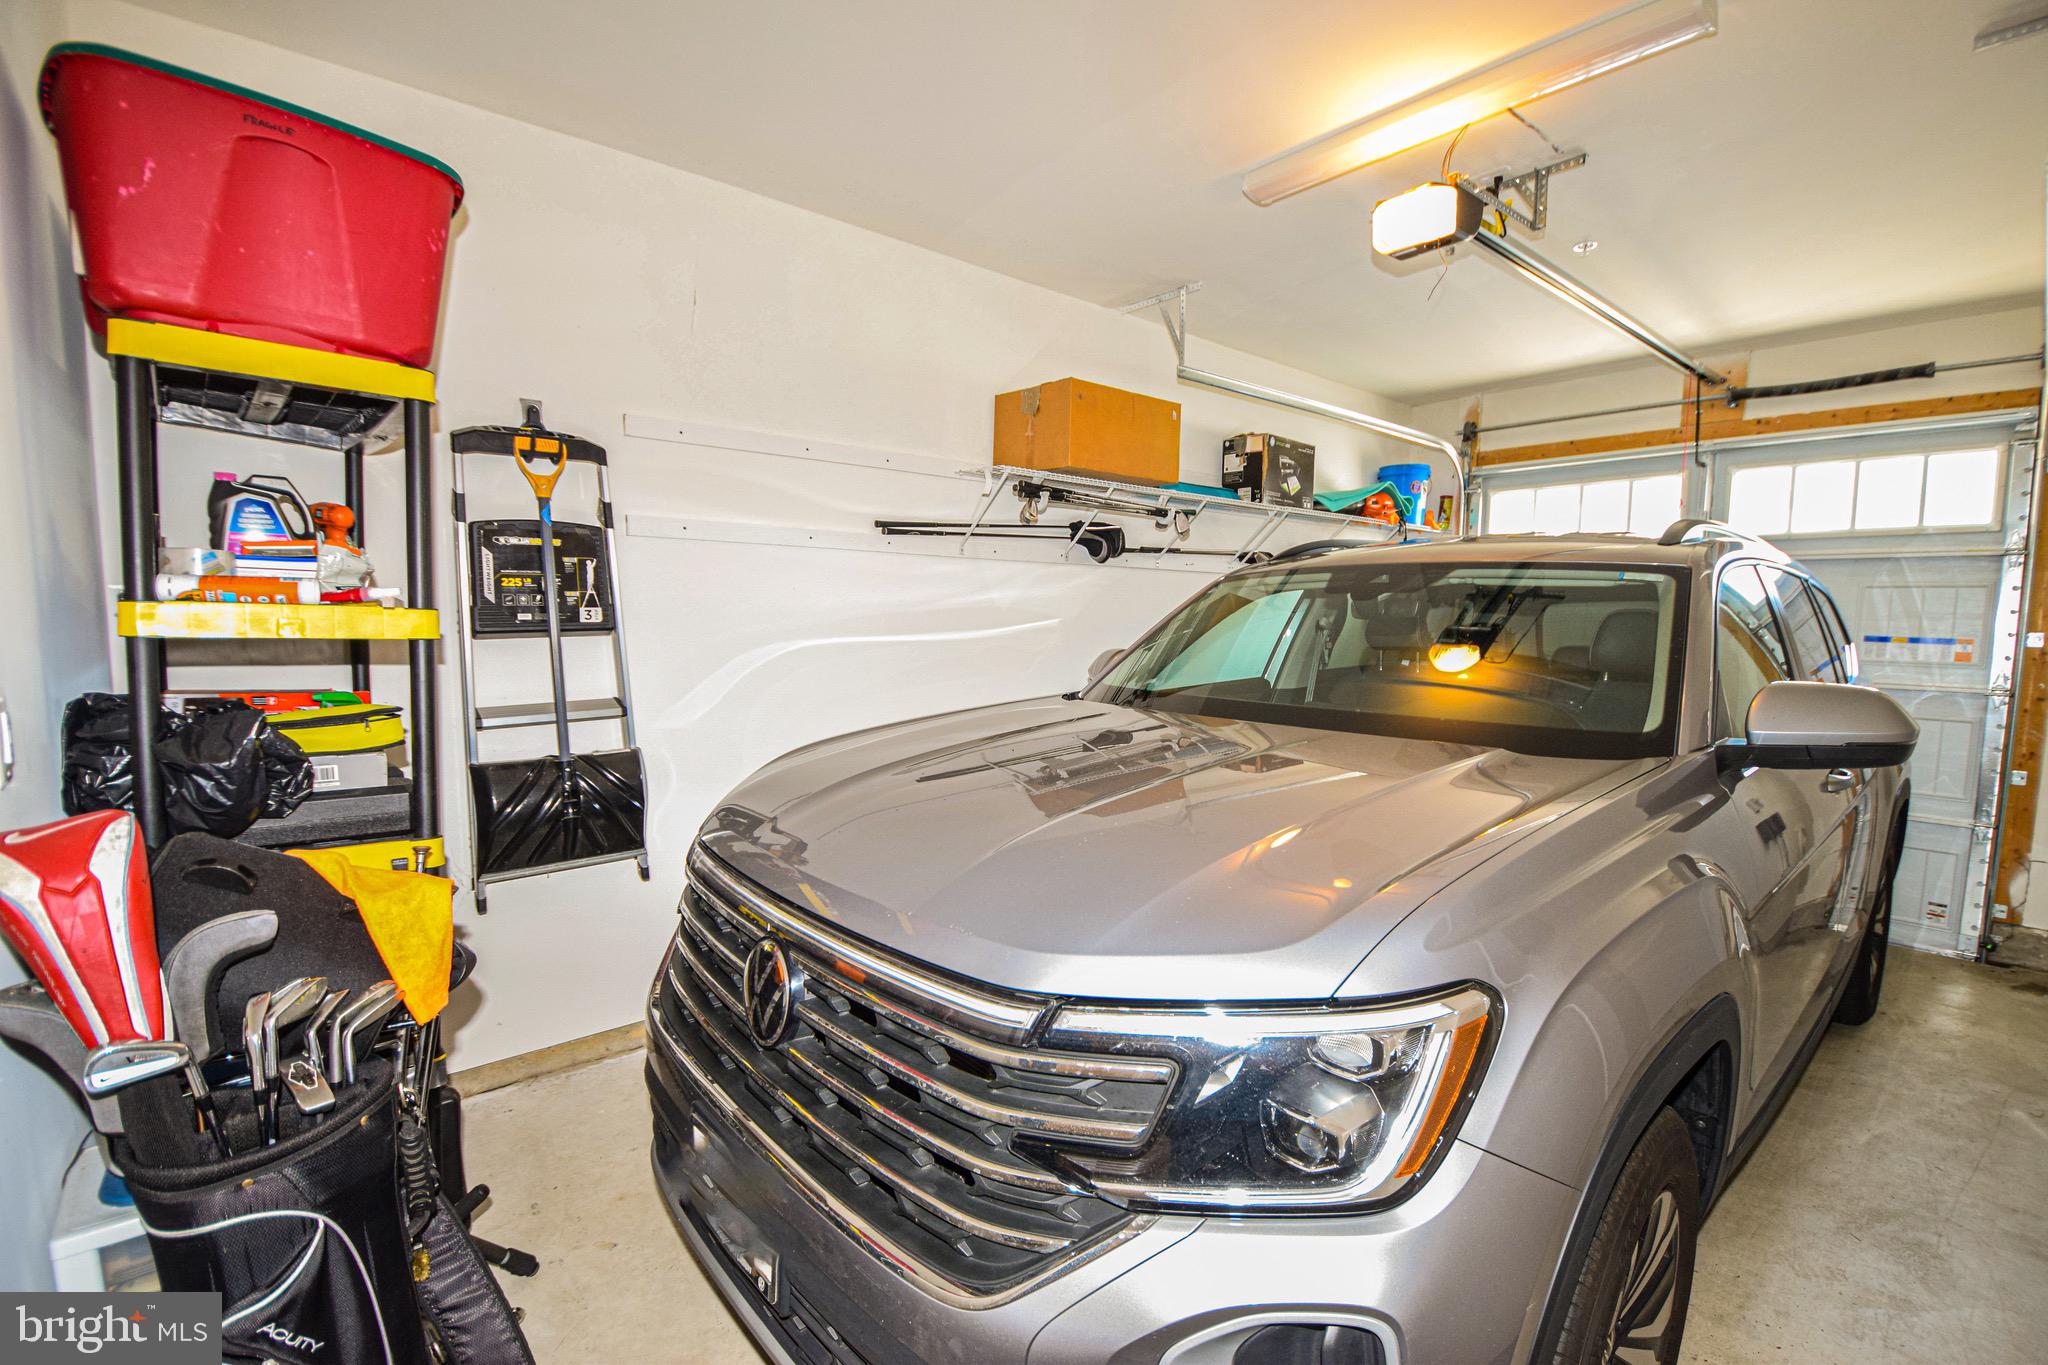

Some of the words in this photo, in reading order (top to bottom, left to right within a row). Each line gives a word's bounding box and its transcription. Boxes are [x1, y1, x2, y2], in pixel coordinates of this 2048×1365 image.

[485, 553, 493, 595] LIGHTWEIGHT
[501, 577, 523, 587] 225
[584, 609, 592, 620] 3
[256, 1322, 324, 1353] ACUITY
